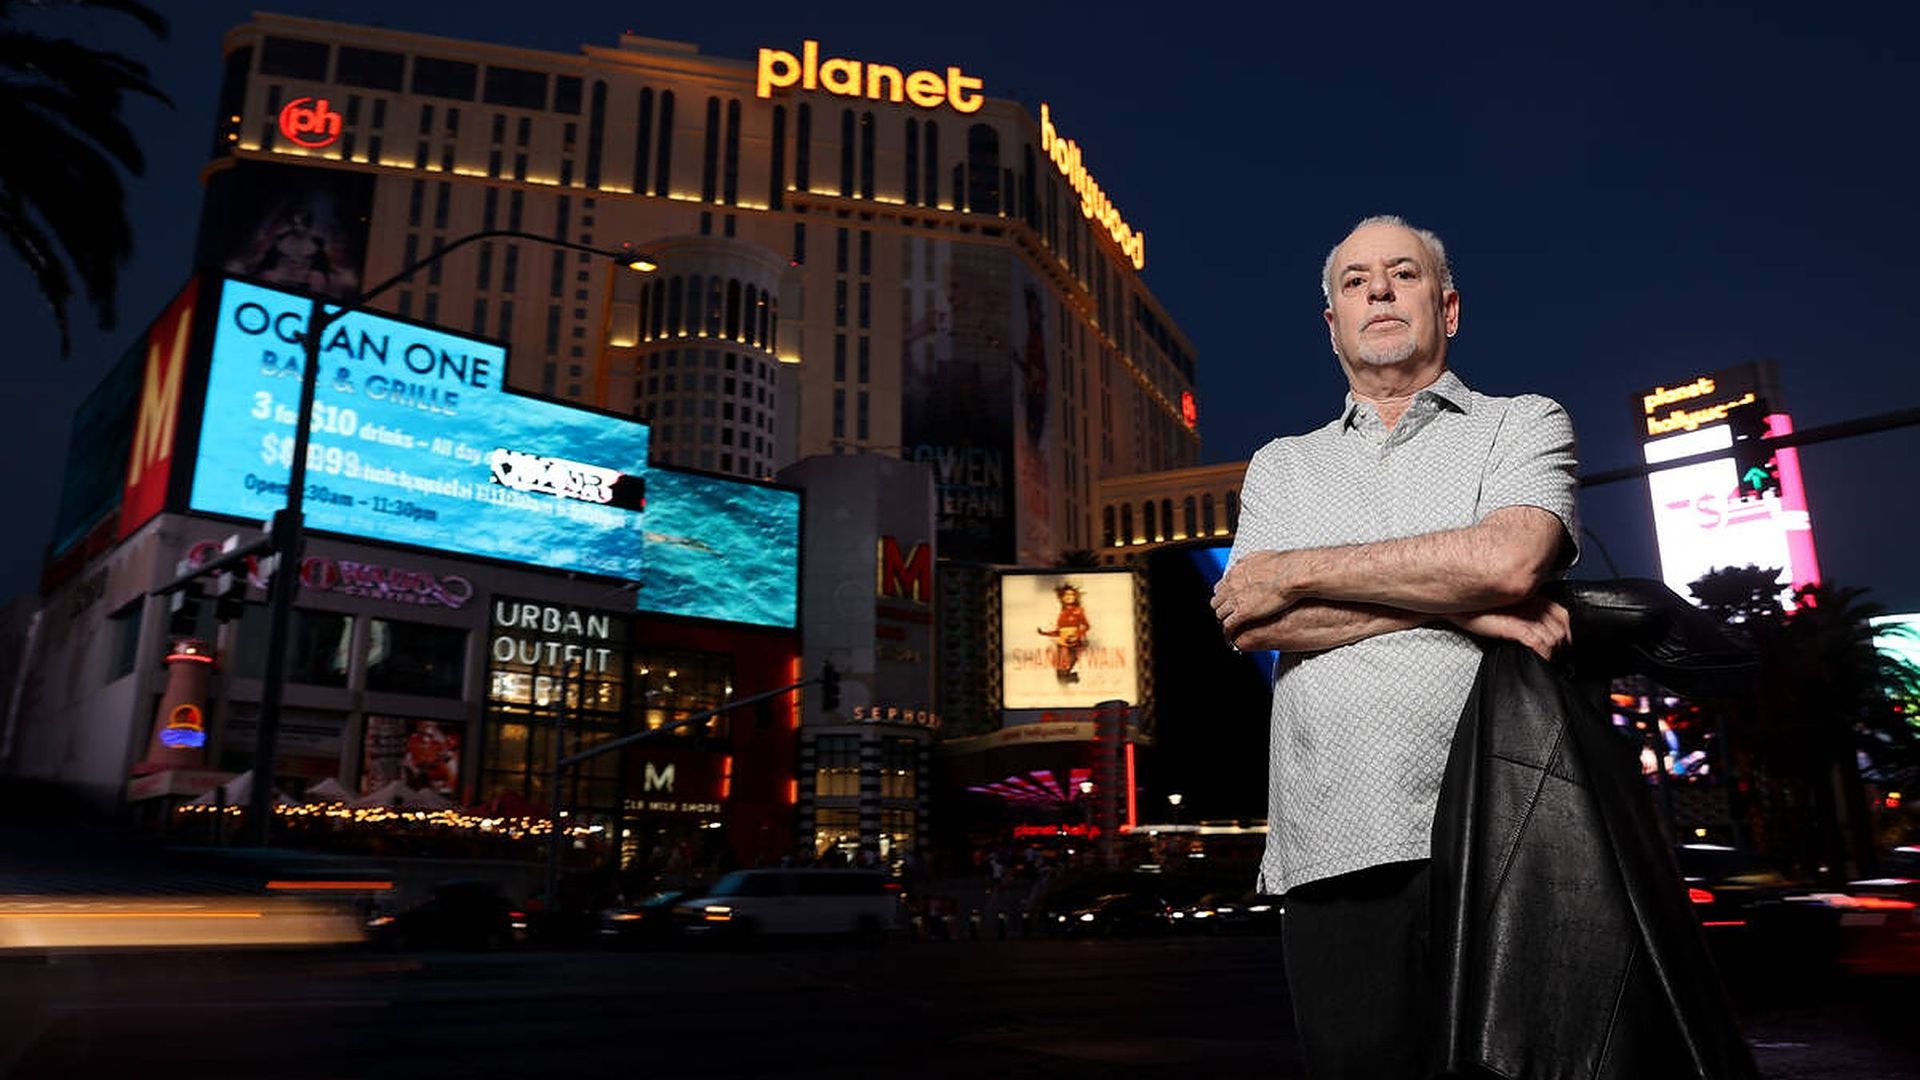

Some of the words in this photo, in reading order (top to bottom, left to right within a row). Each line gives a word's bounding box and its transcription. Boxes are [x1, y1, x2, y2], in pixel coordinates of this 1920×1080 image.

[756, 40, 985, 113] planet
[1040, 102, 1145, 270] hollywood
[235, 302, 389, 364] OCAN
[404, 342, 492, 390] ONE
[128, 303, 193, 488] M
[251, 391, 273, 420] 3
[364, 374, 461, 417] GRILLE
[1643, 377, 1716, 414] planet
[876, 535, 931, 605] M
[496, 600, 611, 640] URBAN
[493, 635, 612, 673] OUTFIT
[643, 760, 676, 794] M
